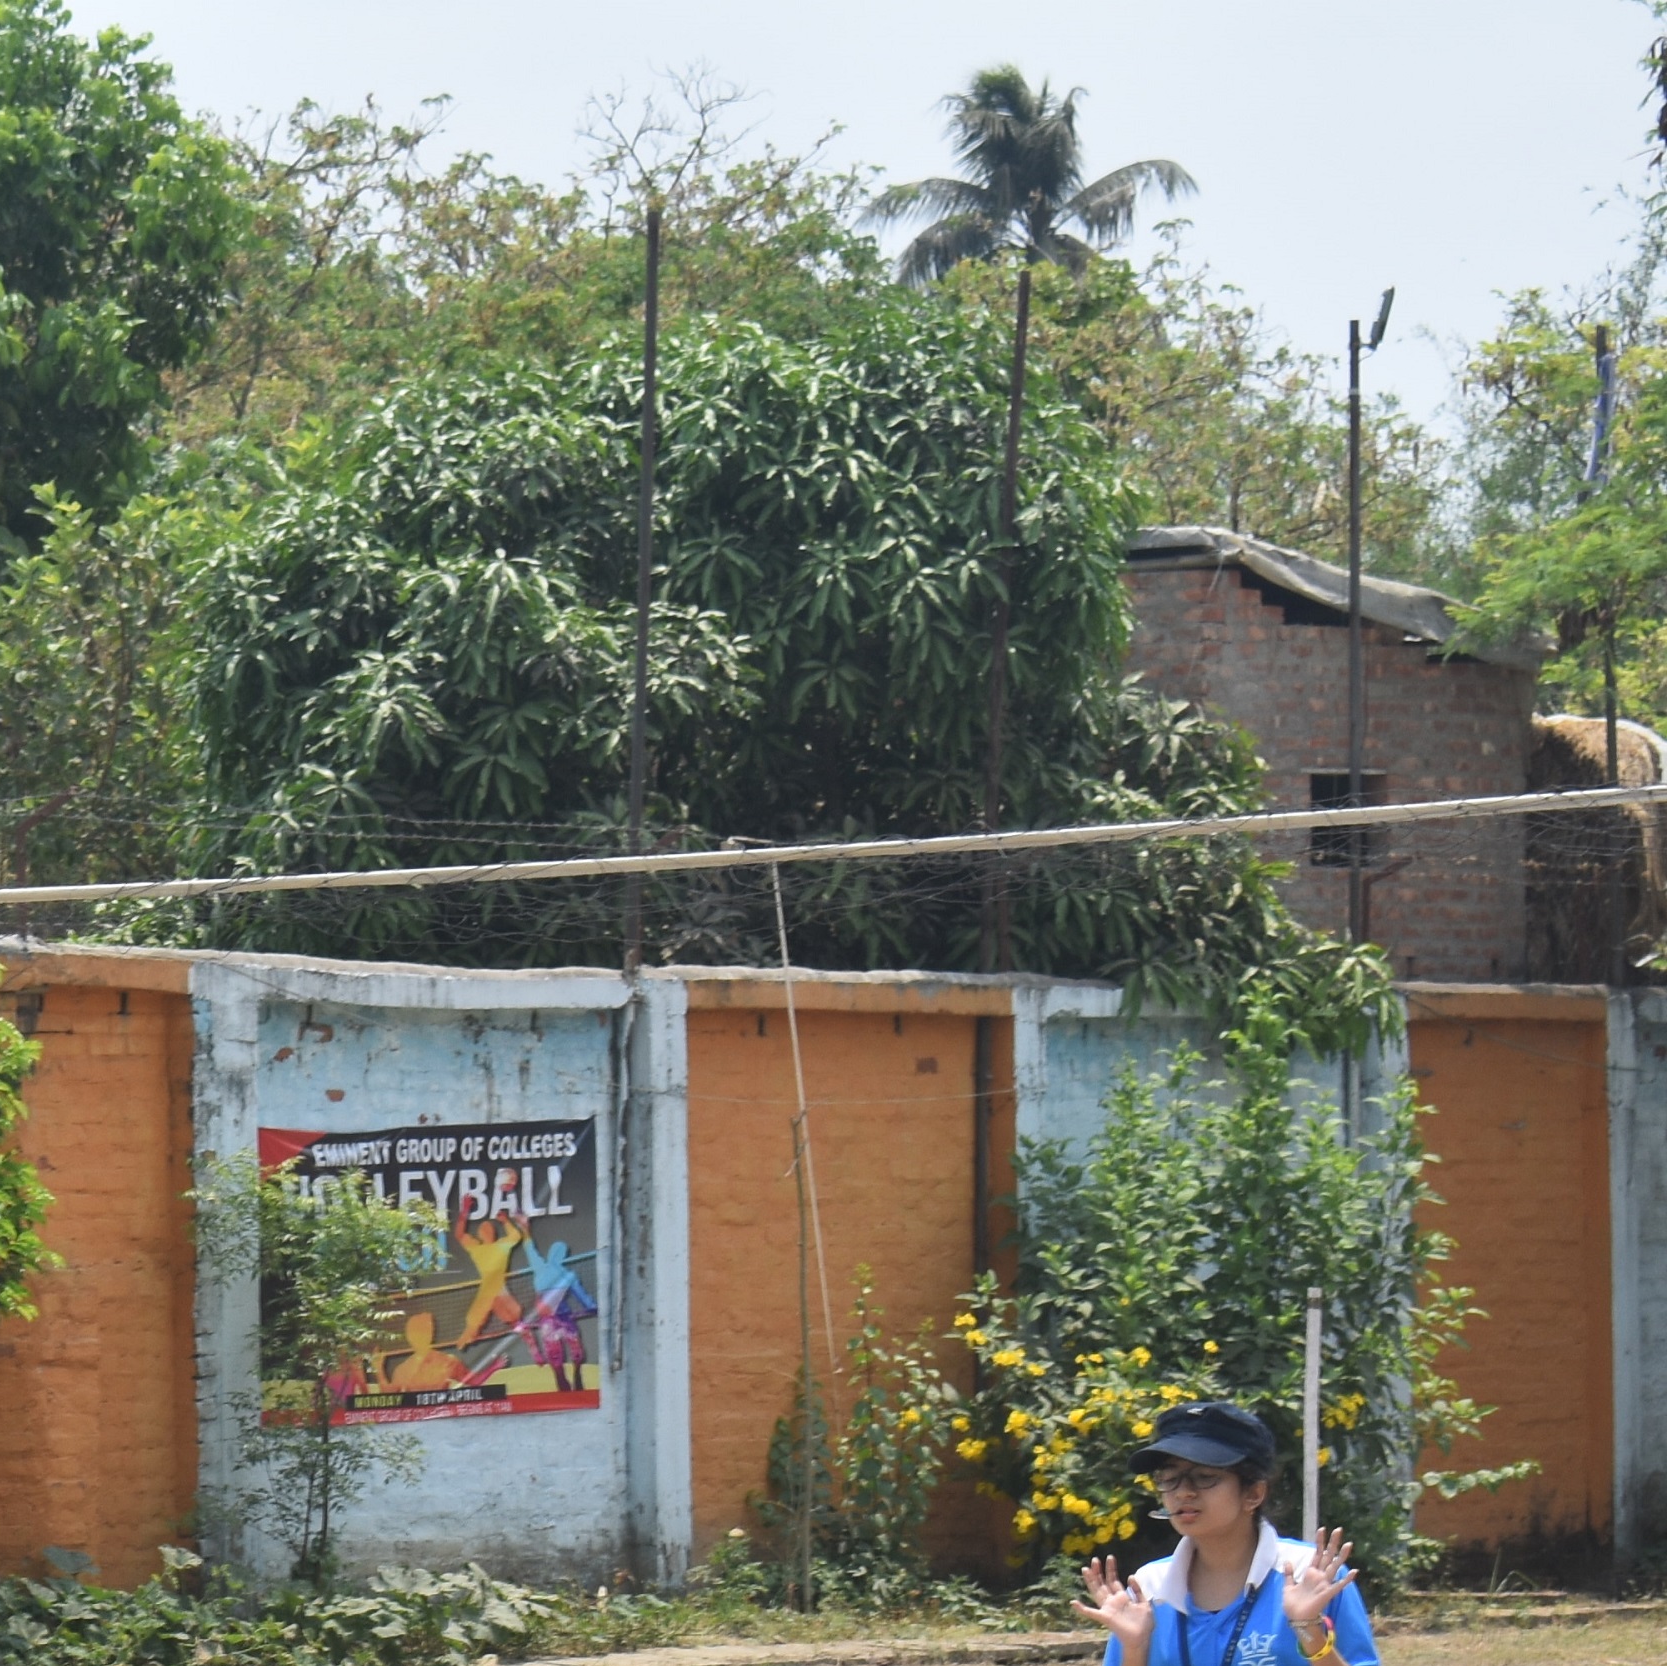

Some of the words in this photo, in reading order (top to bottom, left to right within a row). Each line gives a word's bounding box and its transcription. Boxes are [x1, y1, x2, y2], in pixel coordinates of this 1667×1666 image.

[312, 1140, 392, 1168] EMINENT
[395, 1137, 457, 1164] GROUP
[460, 1136, 486, 1161] OF
[487, 1132, 578, 1161] COLLEGES
[297, 1165, 574, 1220] OEYBALL
